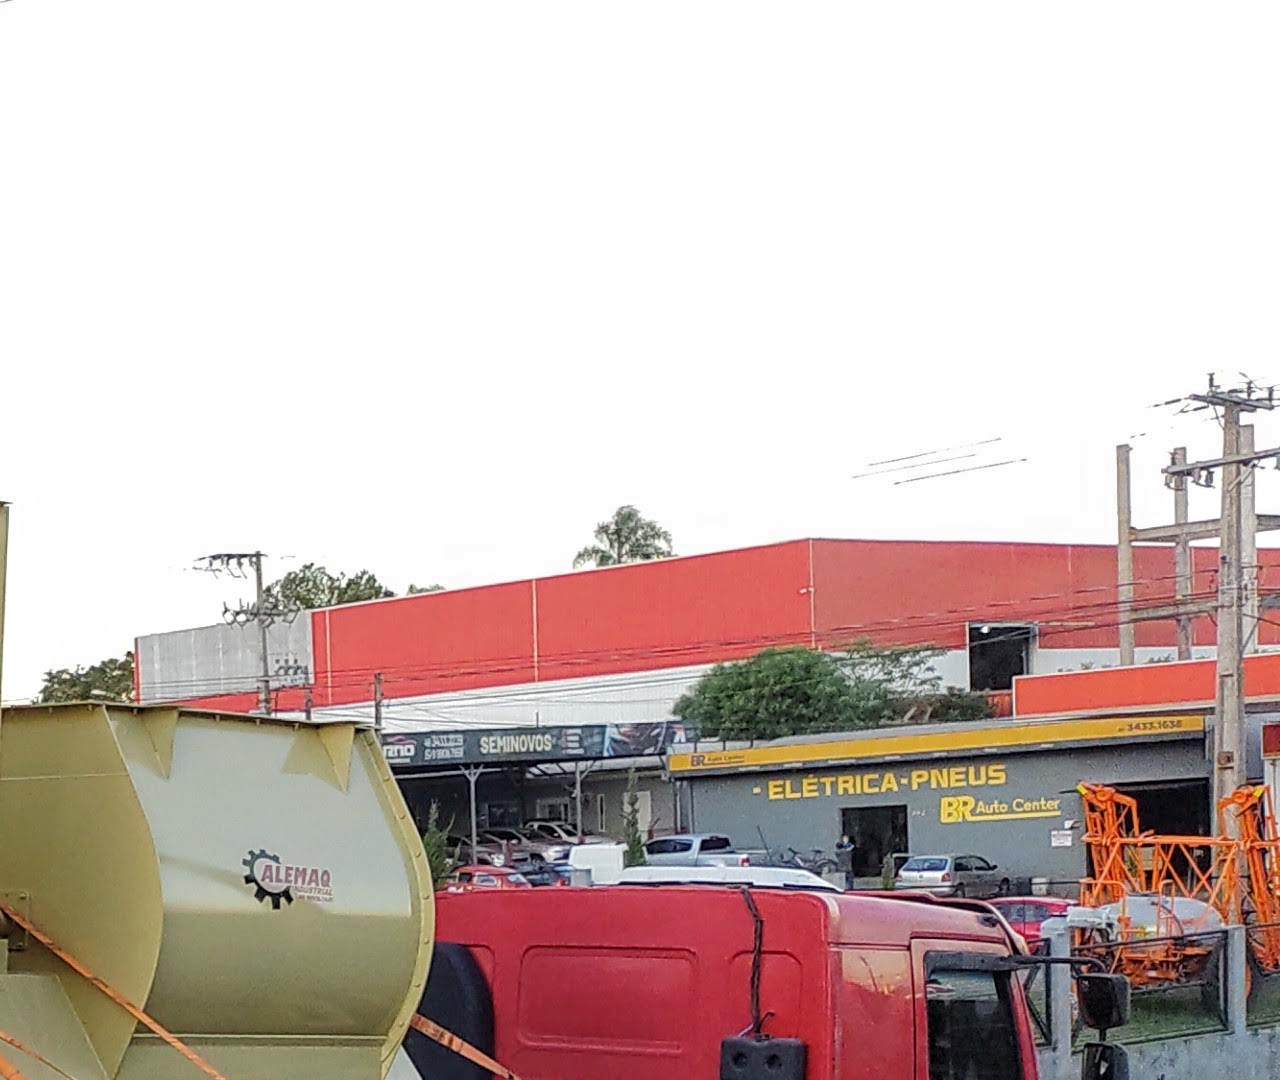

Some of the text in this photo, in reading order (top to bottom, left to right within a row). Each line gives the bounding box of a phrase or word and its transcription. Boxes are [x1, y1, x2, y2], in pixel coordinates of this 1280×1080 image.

[480, 734, 553, 754] SEMINOVOS
[940, 795, 975, 824] BR
[975, 802, 1009, 815] Auto
[1012, 797, 1062, 813] Center
[260, 864, 332, 888] ALEMAQ
